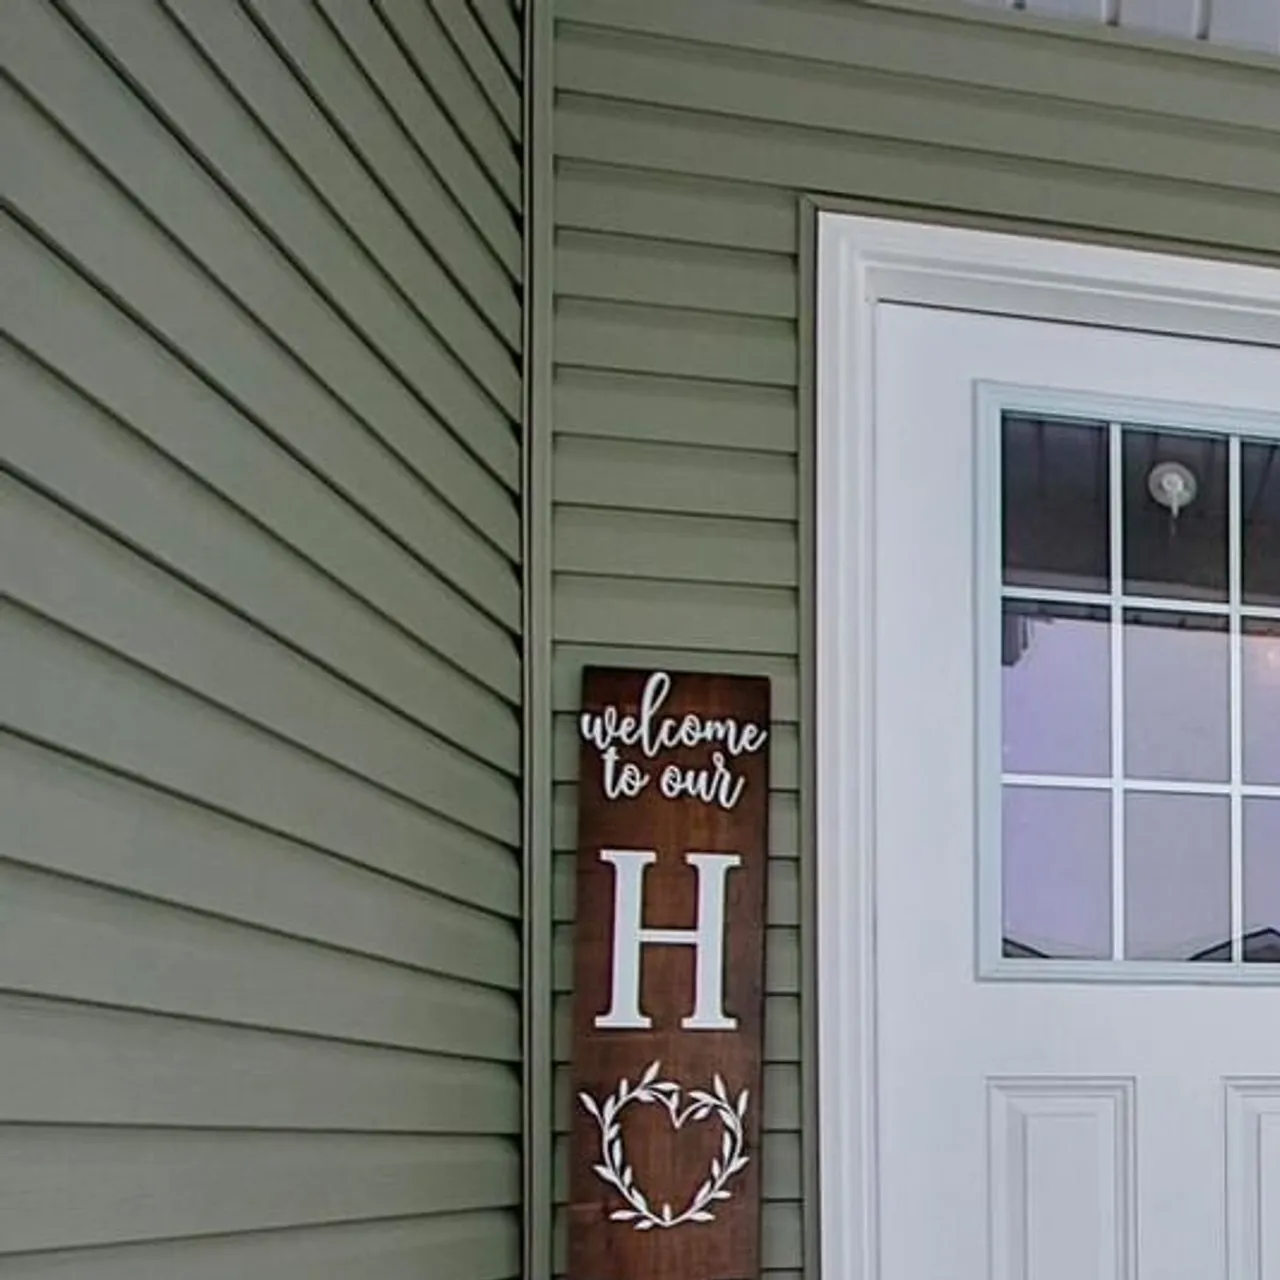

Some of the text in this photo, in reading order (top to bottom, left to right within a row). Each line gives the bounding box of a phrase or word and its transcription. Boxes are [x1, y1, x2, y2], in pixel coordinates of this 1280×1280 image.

[579, 671, 768, 758] welcome
[601, 746, 745, 808] to our
